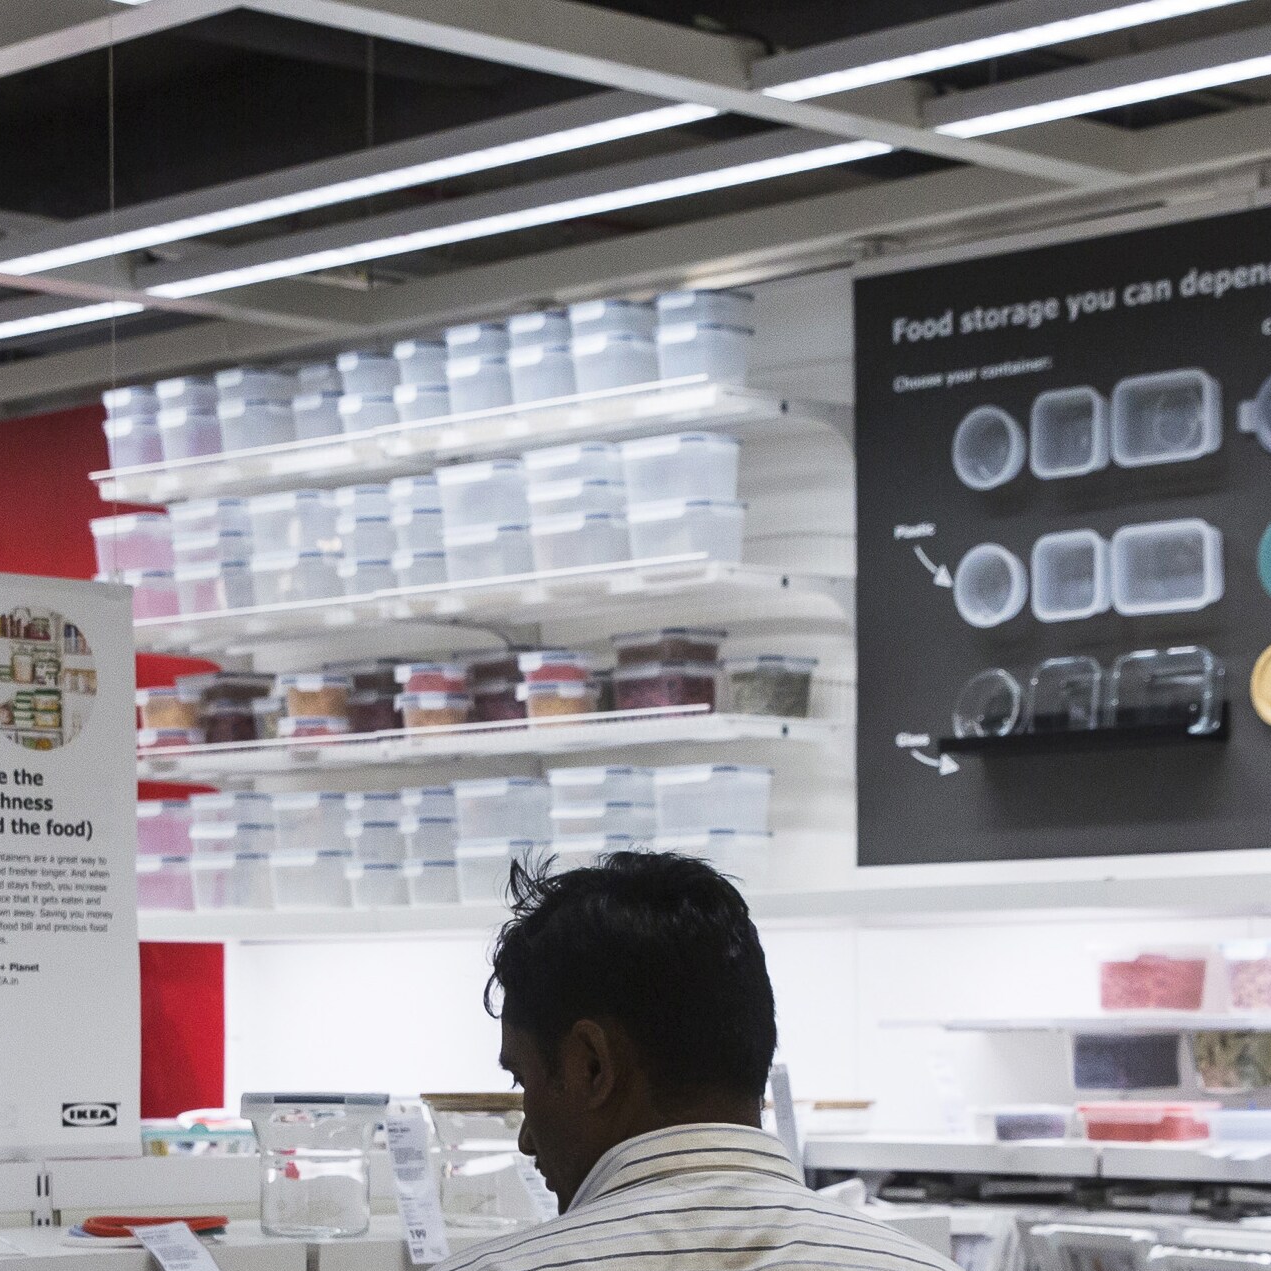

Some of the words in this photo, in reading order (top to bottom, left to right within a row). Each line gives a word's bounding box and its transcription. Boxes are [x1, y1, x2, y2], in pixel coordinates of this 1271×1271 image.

[892, 308, 954, 345] Food
[959, 297, 1060, 334] storage
[1065, 287, 1117, 323] you
[1122, 278, 1173, 307] can
[892, 373, 943, 393] Choose
[945, 368, 978, 387] your
[13, 768, 43, 786] the
[11, 818, 41, 835] the
[46, 819, 92, 841] food)
[34, 854, 47, 863] are
[57, 855, 78, 865] great
[80, 856, 96, 866] way
[98, 856, 108, 865] to
[8, 867, 38, 876] fresher
[71, 869, 87, 878] And
[89, 869, 110, 878] when
[7, 881, 29, 891] stays
[57, 883, 73, 892] you
[75, 883, 108, 892] increase
[13, 894, 29, 903] that
[41, 896, 59, 906] gets
[61, 896, 84, 905] eaten
[86, 895, 102, 905] and
[40, 909, 68, 919] Saving
[69, 910, 85, 919] you
[86, 910, 113, 920] money
[0, 921, 19, 931] food
[21, 922, 34, 931] bill
[36, 922, 52, 932] and
[54, 923, 88, 933] precious
[89, 922, 109, 932] food
[9, 962, 40, 973] Planet
